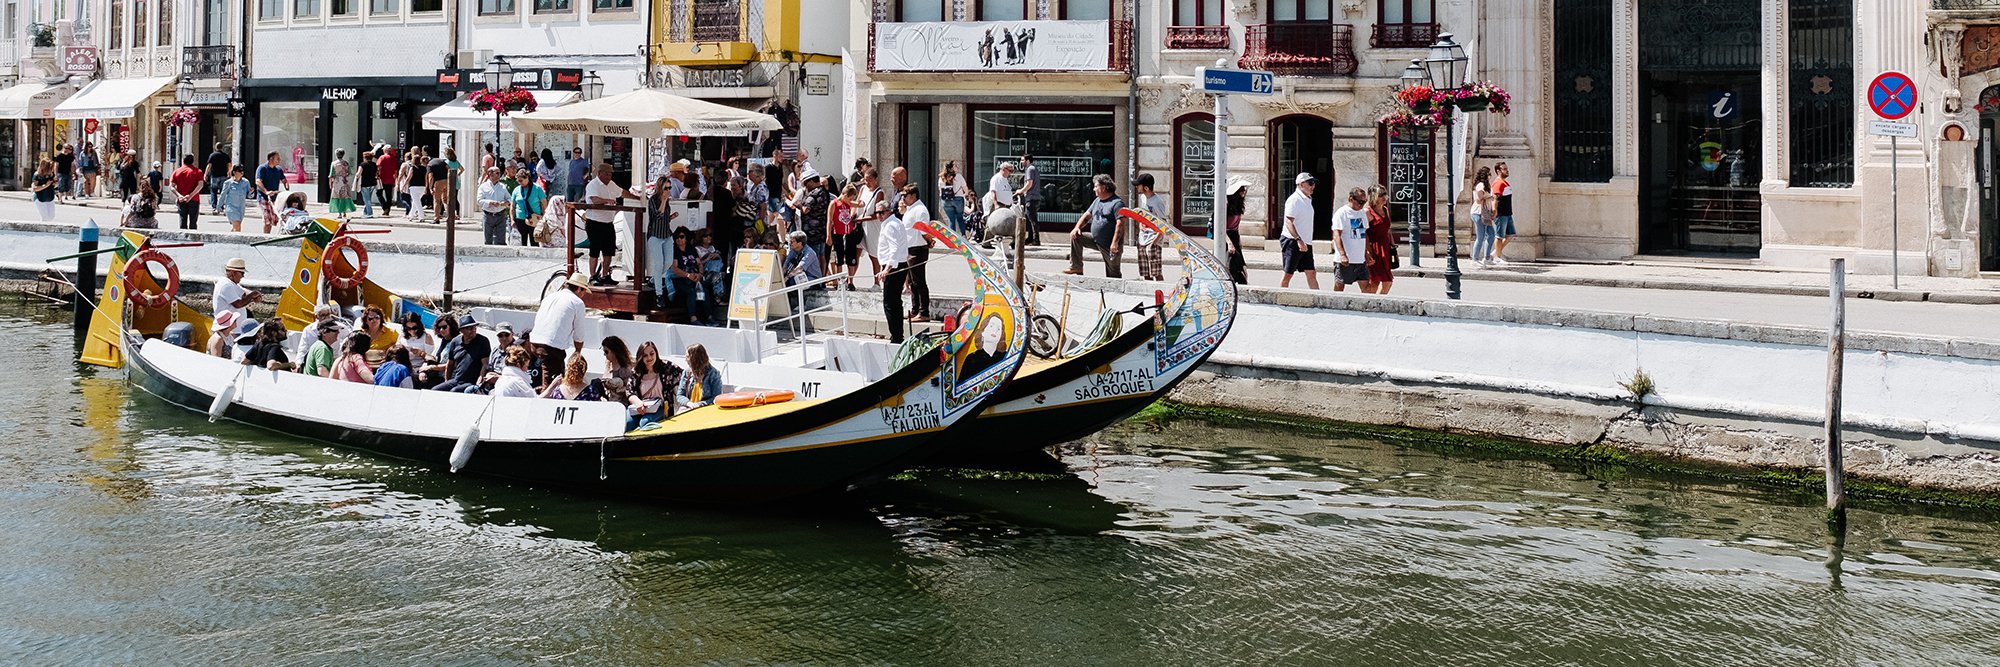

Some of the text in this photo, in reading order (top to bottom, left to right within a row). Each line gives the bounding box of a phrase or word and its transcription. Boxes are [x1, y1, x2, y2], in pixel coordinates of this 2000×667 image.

[65, 48, 97, 64] GALERIA
[67, 63, 94, 71] ROSSIO
[683, 69, 744, 87] MARQUES
[1205, 76, 1227, 85] turismo
[322, 88, 358, 99] ALE-HOP
[603, 125, 630, 135] CRUISES
[1096, 367, 1154, 386] A-2717-AL
[801, 382, 821, 398] MT
[1074, 379, 1155, 400] SÃO ROQUE I
[553, 407, 578, 425] MT
